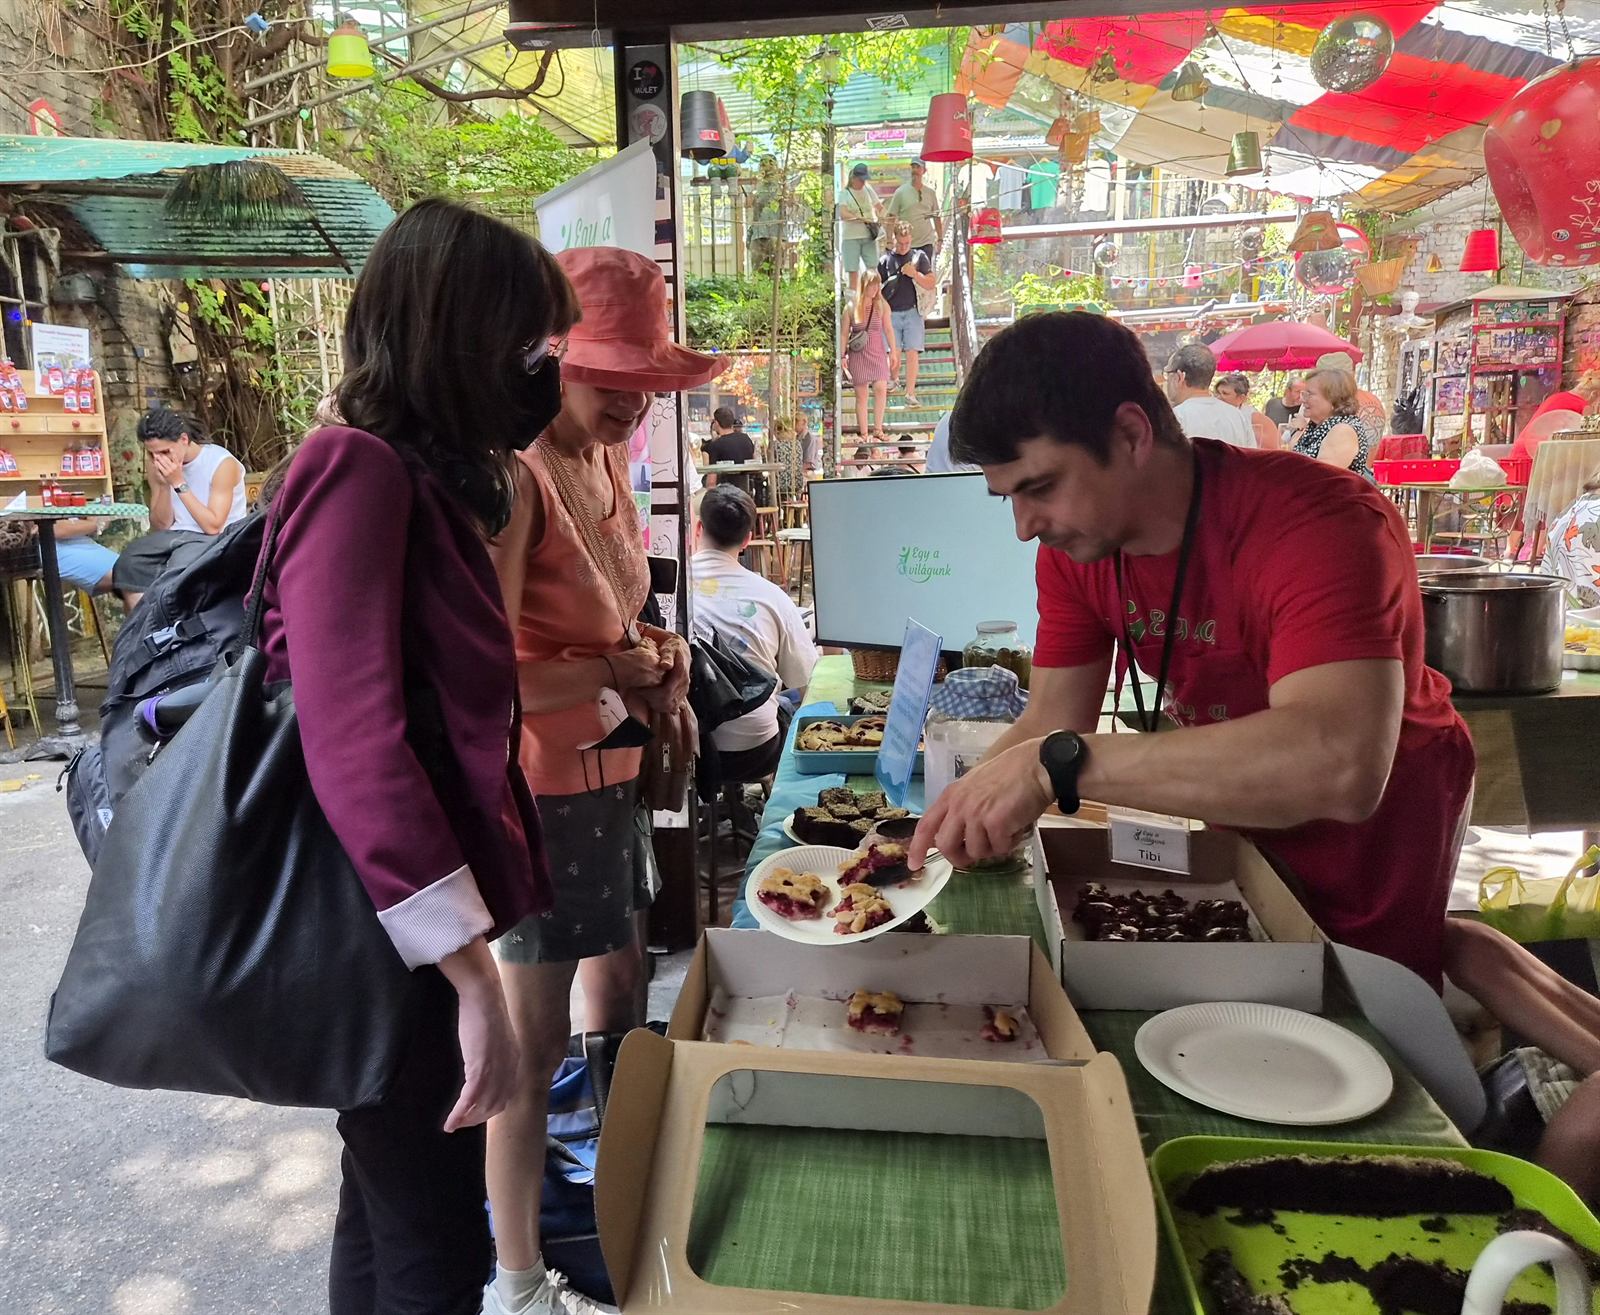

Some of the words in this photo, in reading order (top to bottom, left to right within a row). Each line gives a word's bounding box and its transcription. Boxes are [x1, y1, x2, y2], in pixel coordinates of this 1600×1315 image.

[912, 546, 930, 561] Egy
[932, 550, 940, 559] a
[908, 563, 952, 579] világunk
[1138, 849, 1161, 862] Tibi
